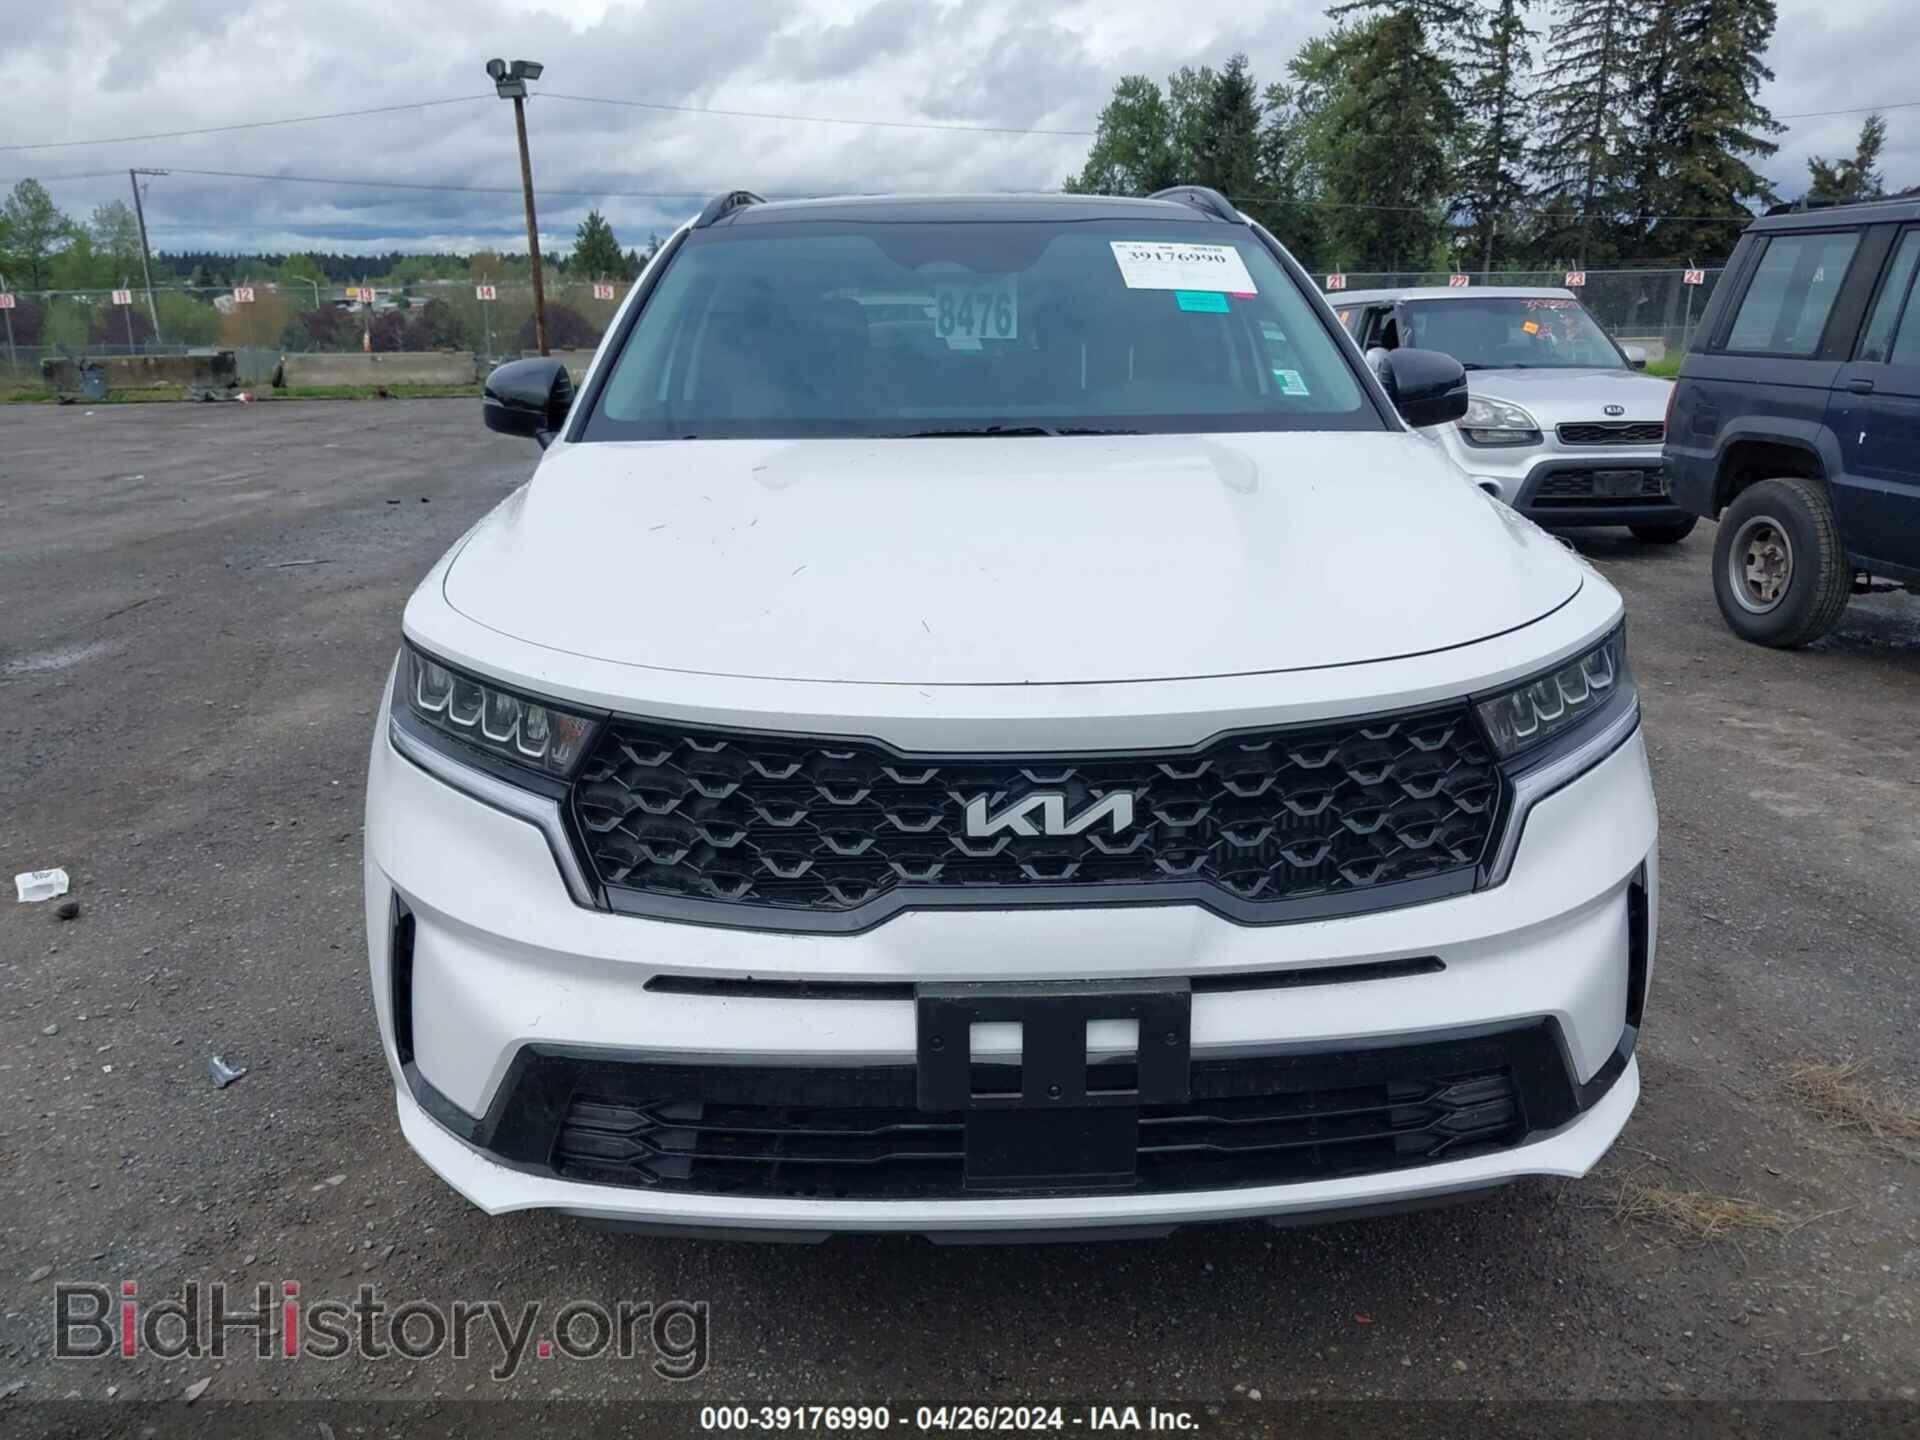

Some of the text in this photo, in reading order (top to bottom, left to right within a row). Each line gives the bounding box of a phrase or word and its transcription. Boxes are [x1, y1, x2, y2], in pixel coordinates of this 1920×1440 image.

[1128, 251, 1226, 264] 39176990
[1329, 275, 1342, 288] 21
[1452, 276, 1466, 287] 22
[1568, 273, 1583, 285] 23
[1686, 271, 1701, 283] 24
[237, 288, 251, 301] 12
[481, 287, 493, 299] 14
[599, 286, 611, 298] 15
[938, 293, 1012, 336] 8476
